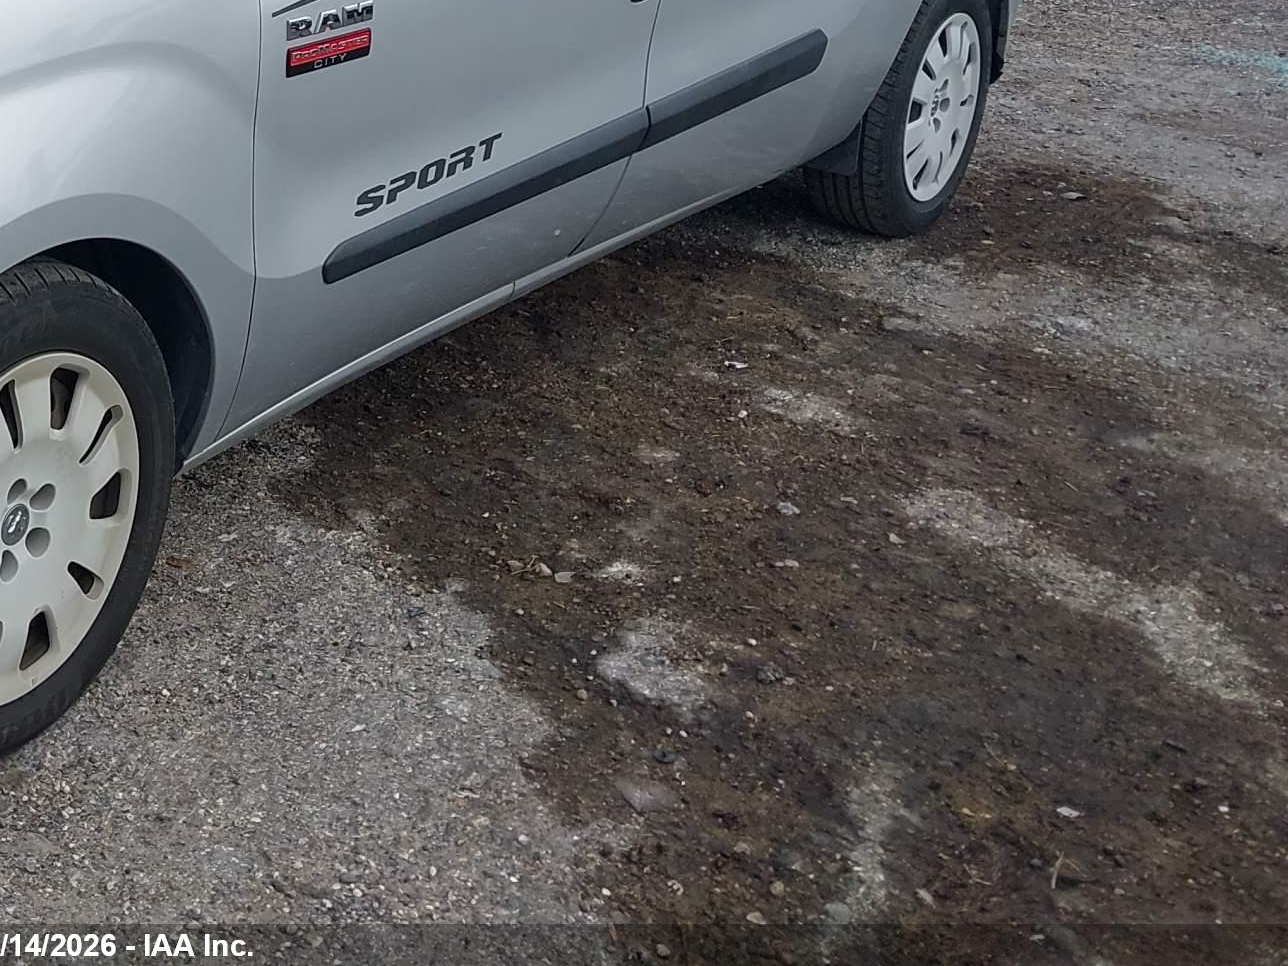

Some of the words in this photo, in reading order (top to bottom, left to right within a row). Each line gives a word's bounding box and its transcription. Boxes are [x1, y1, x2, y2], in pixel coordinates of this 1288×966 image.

[287, 0, 374, 41] RAM
[314, 53, 347, 68] CITY
[354, 132, 502, 217] SPORT
